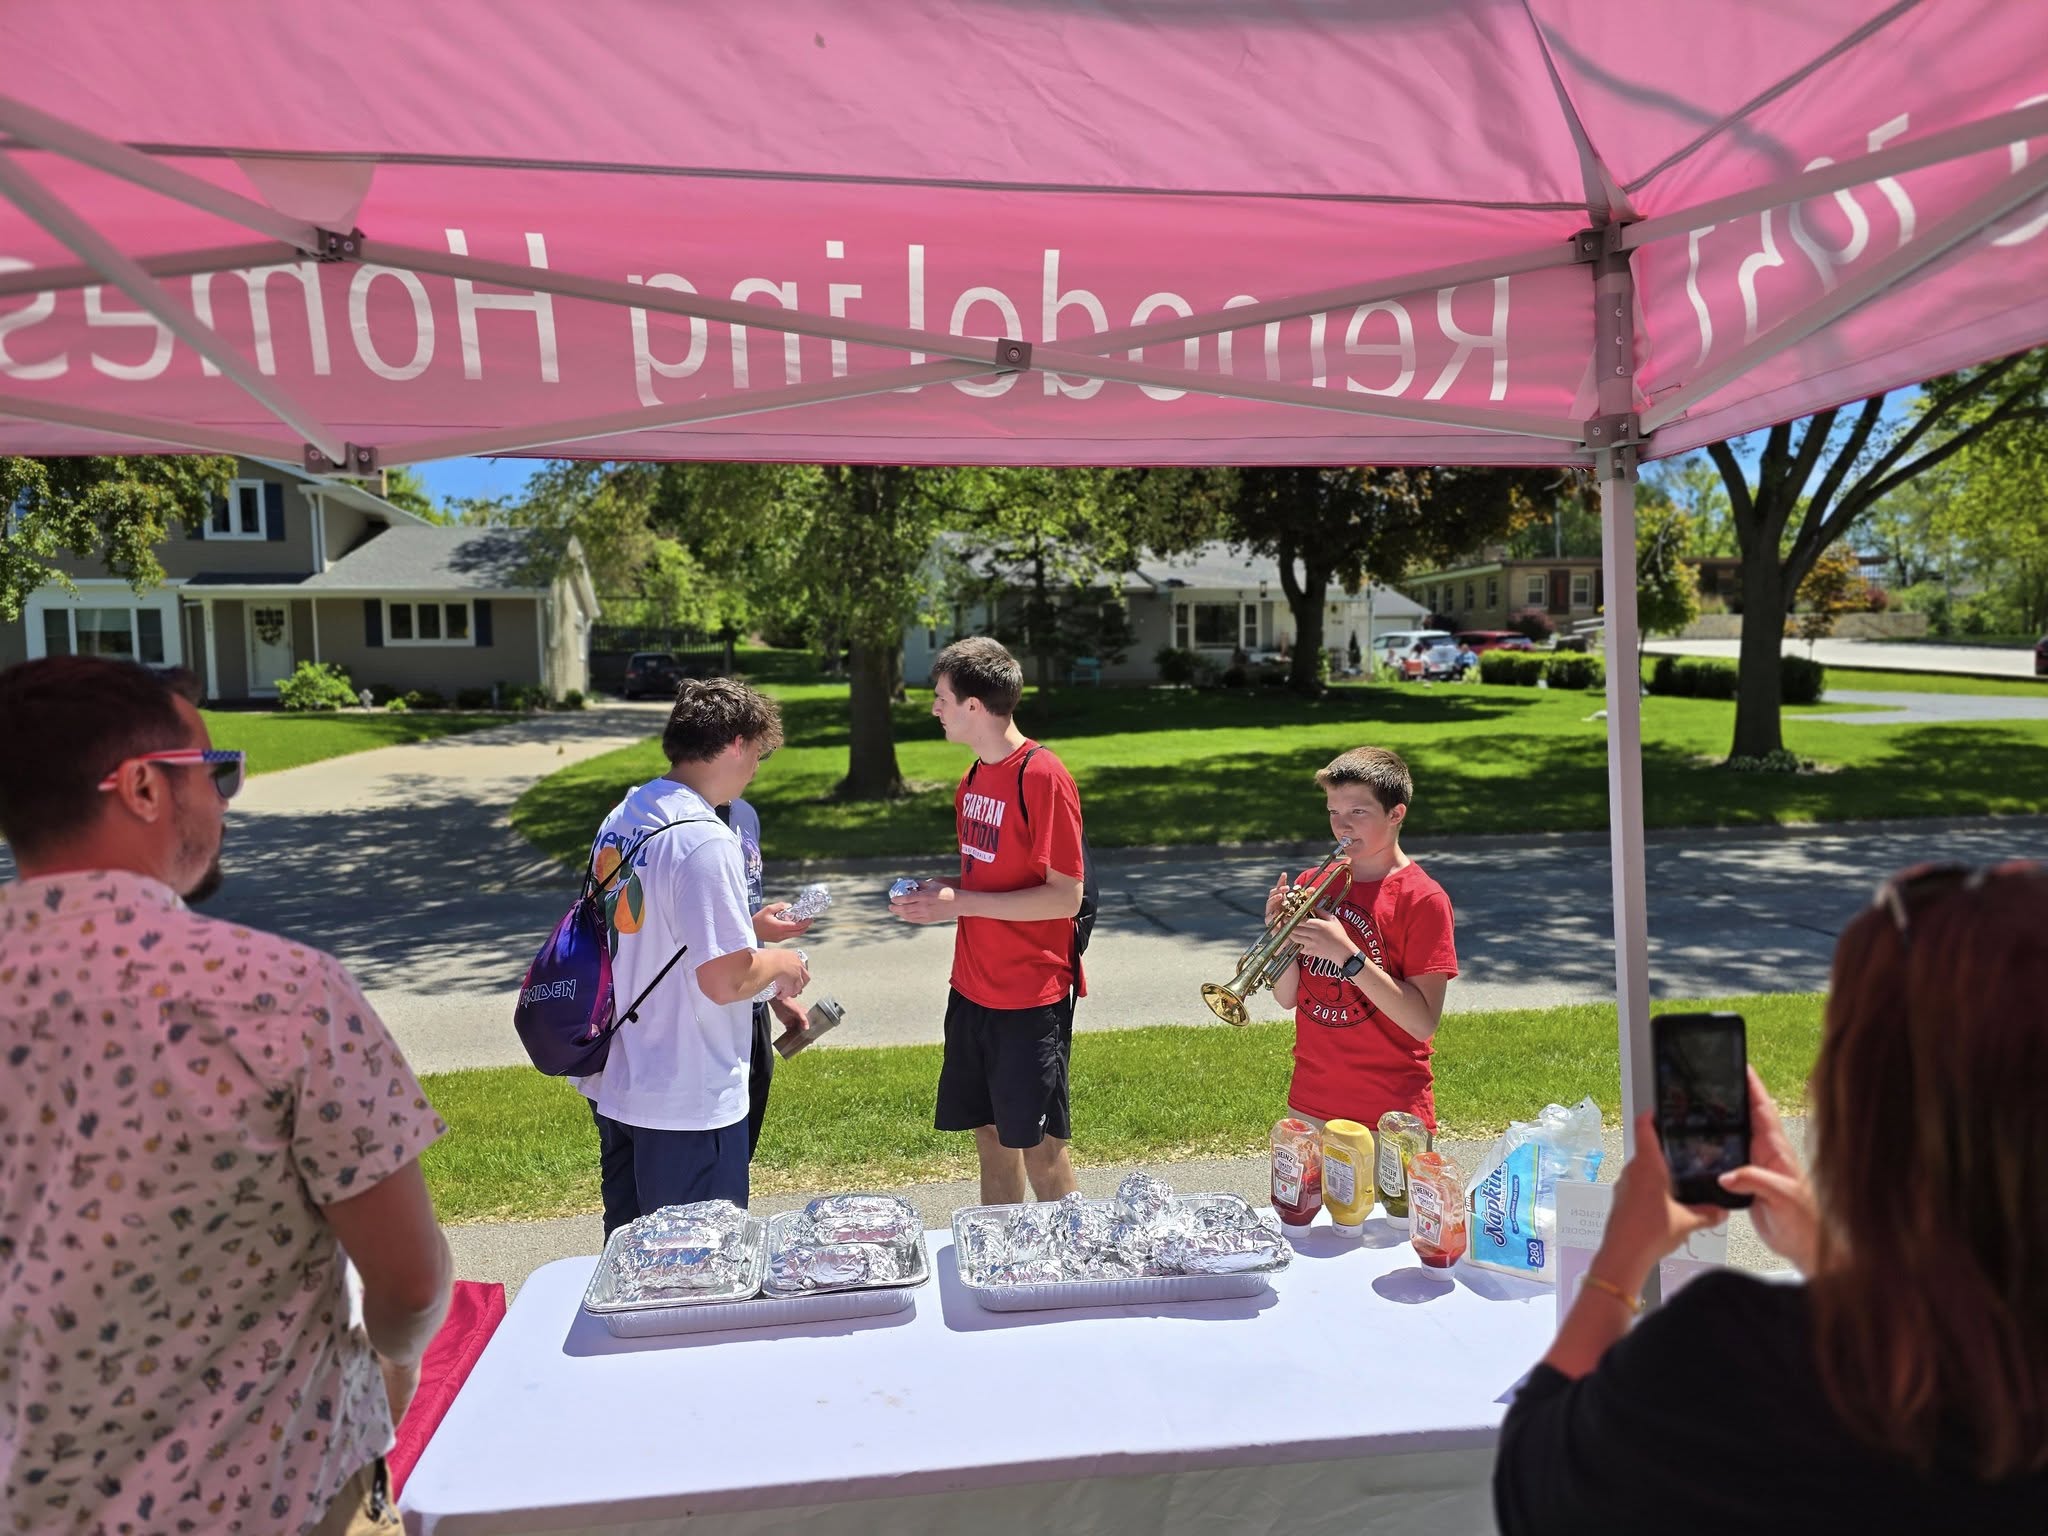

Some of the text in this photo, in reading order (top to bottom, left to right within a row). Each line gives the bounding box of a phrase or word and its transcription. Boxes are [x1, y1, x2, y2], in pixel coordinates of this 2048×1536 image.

[962, 819, 1000, 852] ATION
[1344, 909, 1373, 939] MIDDLE
[1313, 1004, 1348, 1022] 2024
[1415, 1186, 1434, 1200] HEINZ
[1482, 1162, 1506, 1246] Napkin
[1529, 1242, 1540, 1264] 280
